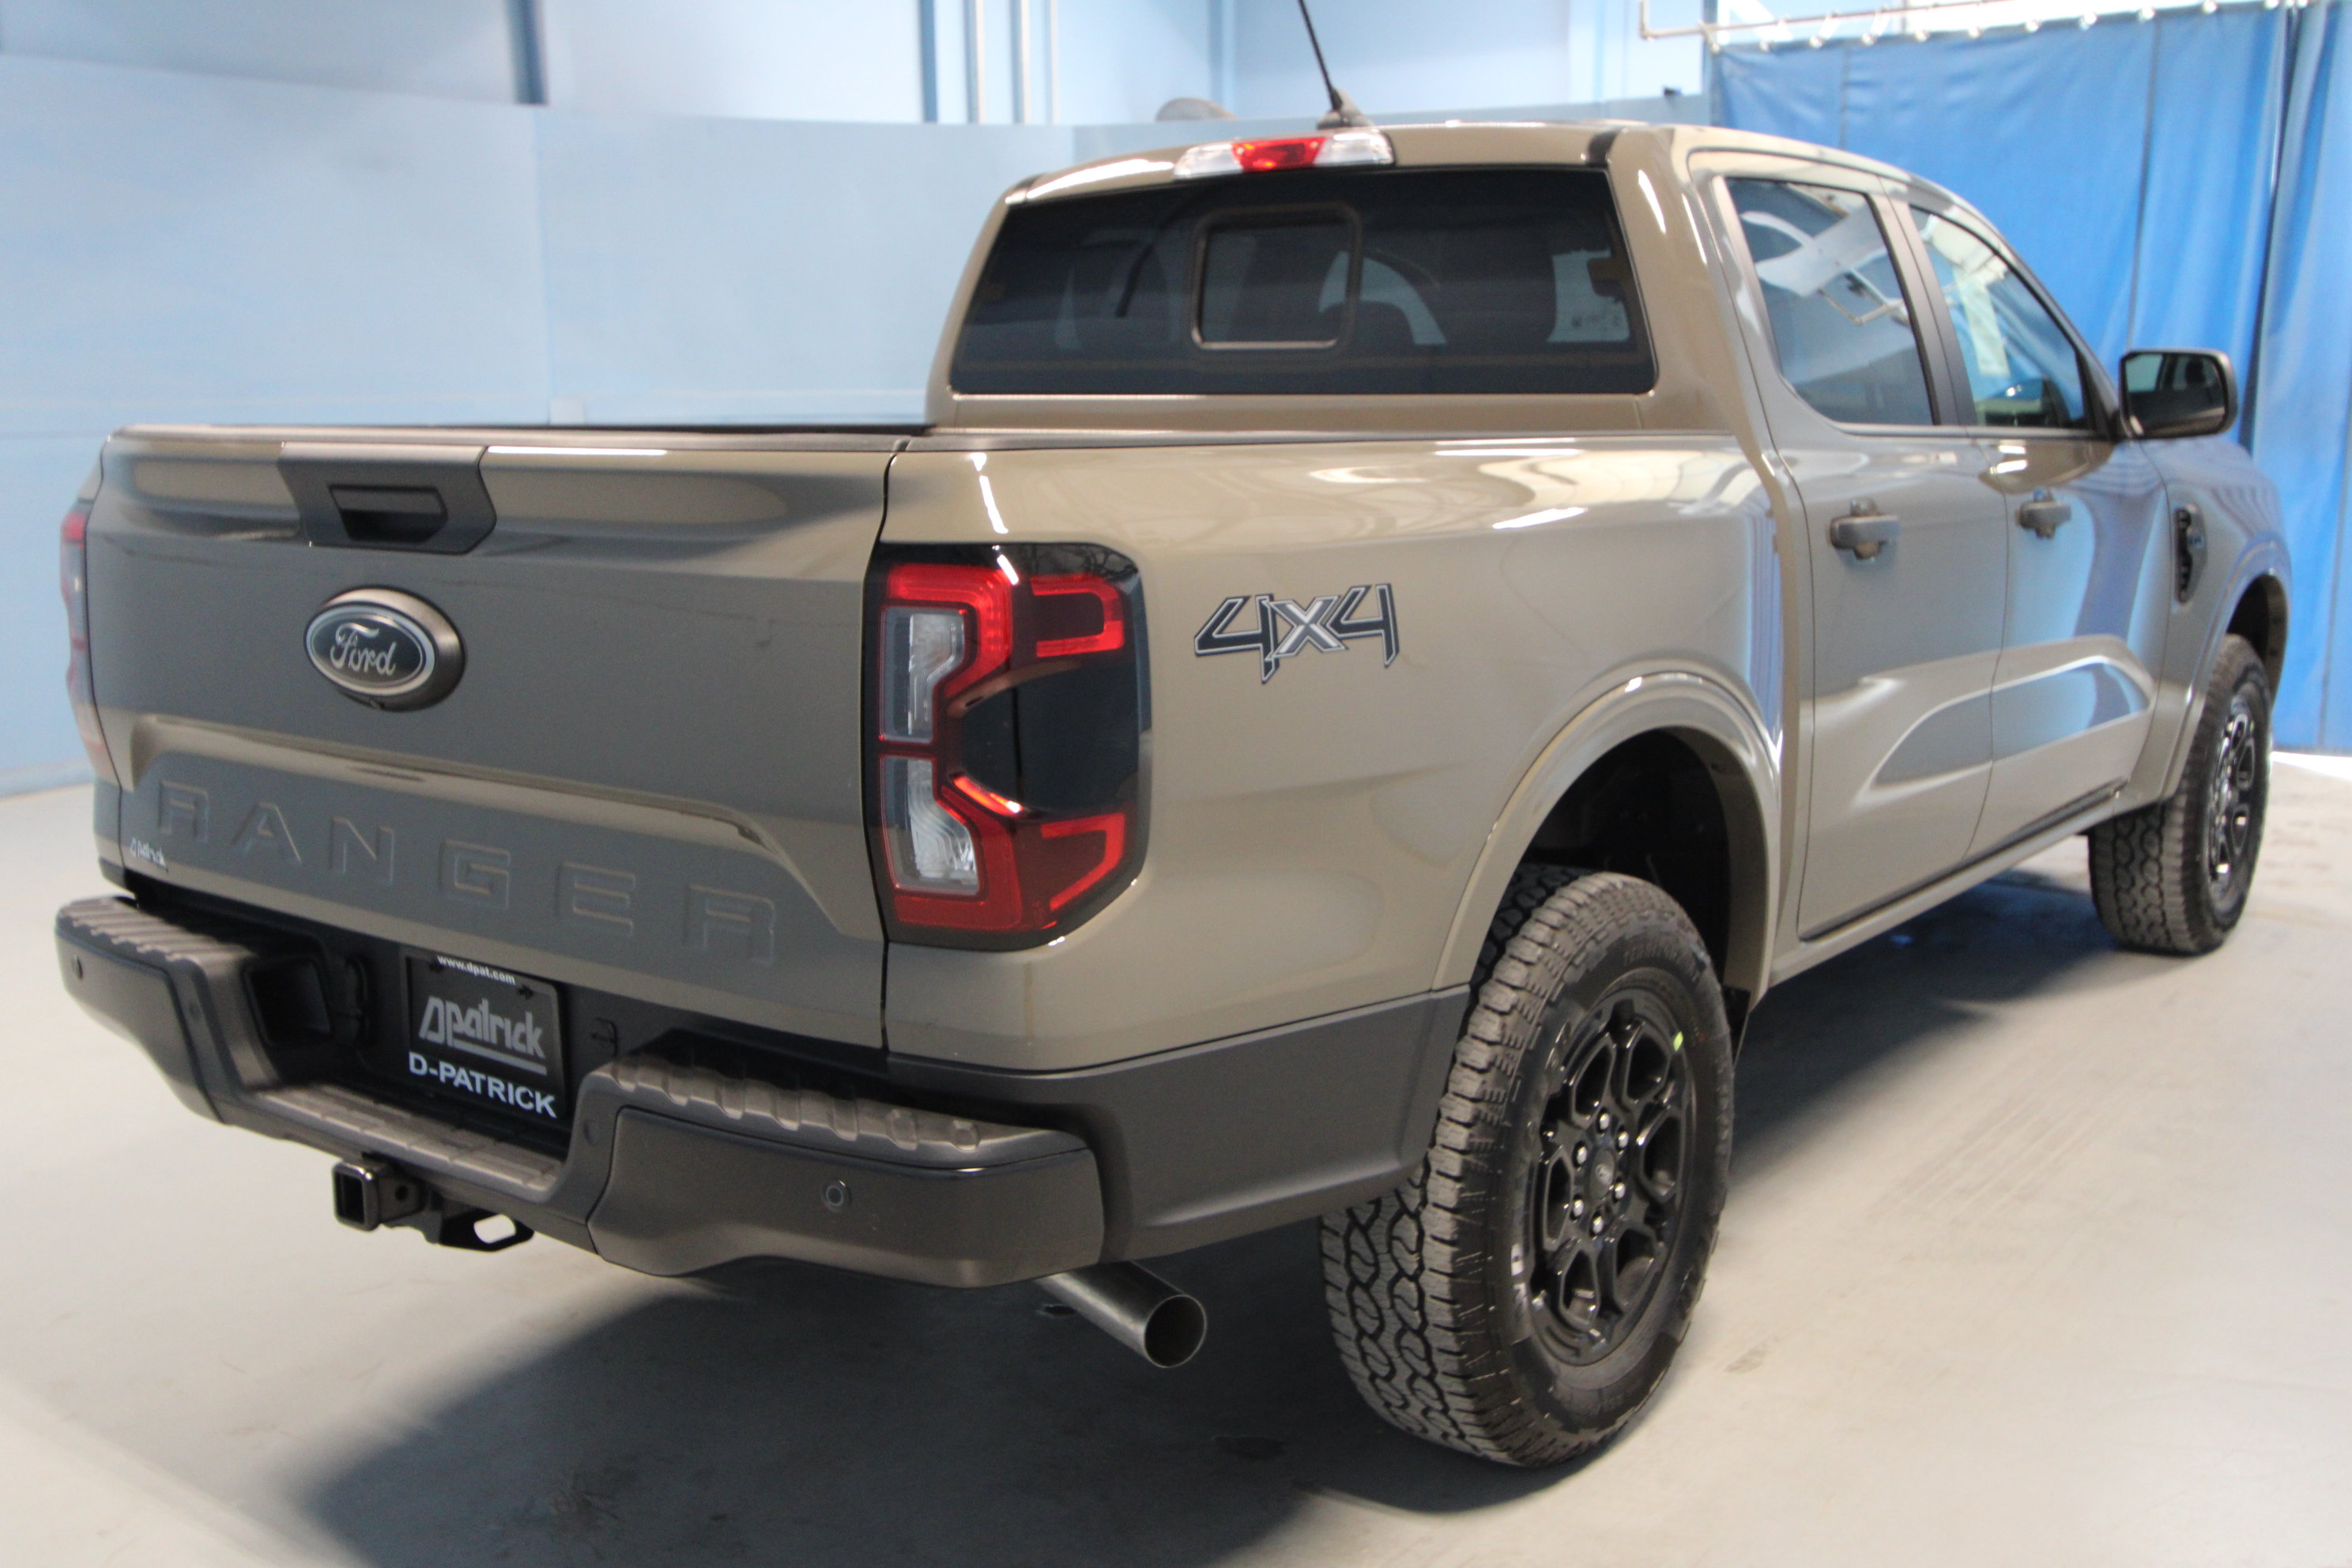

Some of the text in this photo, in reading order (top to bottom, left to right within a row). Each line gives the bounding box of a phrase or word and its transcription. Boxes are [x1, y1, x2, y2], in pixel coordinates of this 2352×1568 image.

[330, 622, 397, 677] Ford
[158, 778, 777, 967] RANGER
[437, 955, 516, 986] www.dpat.com
[409, 1051, 556, 1118] D-PATRICK
